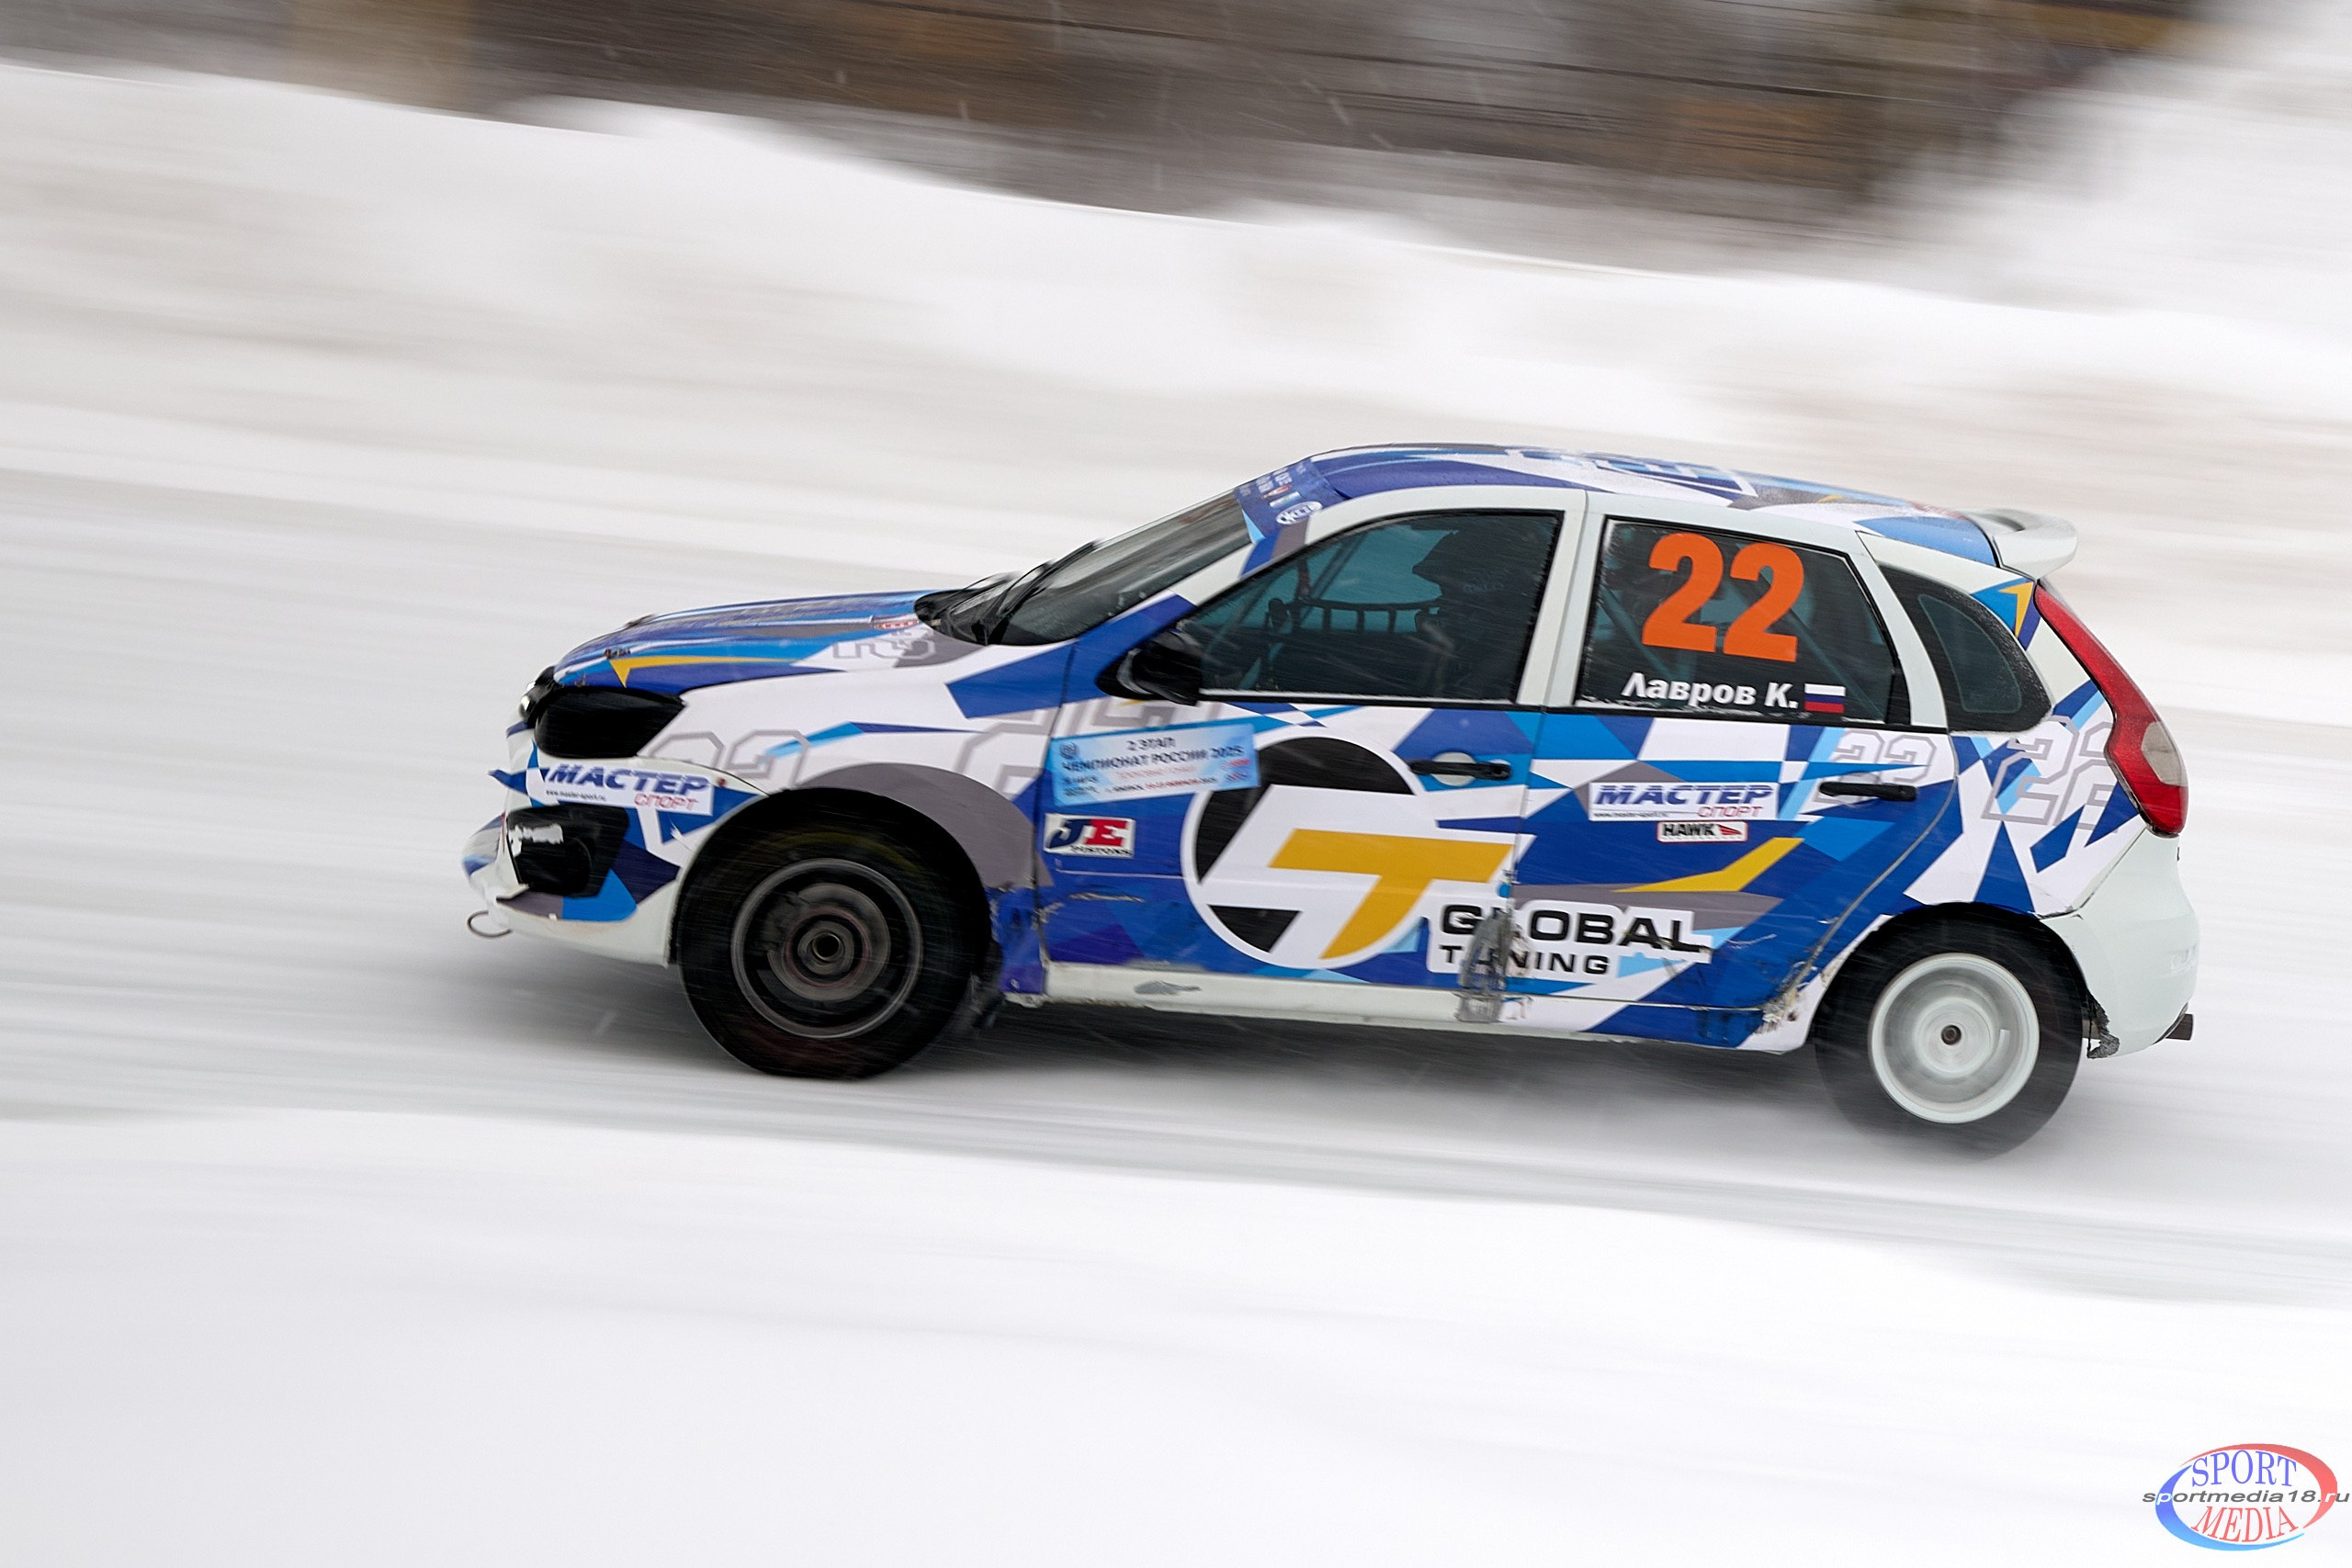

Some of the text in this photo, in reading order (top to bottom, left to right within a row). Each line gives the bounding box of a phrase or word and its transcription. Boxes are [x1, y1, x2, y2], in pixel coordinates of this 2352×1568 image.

[1642, 532, 1804, 662] 22
[1621, 672, 1799, 709] Лавров К.
[1062, 753, 1148, 773] ЧЕМПИОНАТ
[1151, 750, 1208, 765] РОССИИ
[1210, 745, 1245, 759] 2025
[1126, 737, 1177, 751] 2 ЭТАП
[548, 763, 710, 796] МАСТЕР
[1595, 784, 1773, 805] МАСТЕР
[1047, 818, 1129, 849] JE
[1663, 823, 1717, 836] HAWK
[1442, 904, 1712, 953] GOBAL
[1439, 944, 1611, 976] TNING
